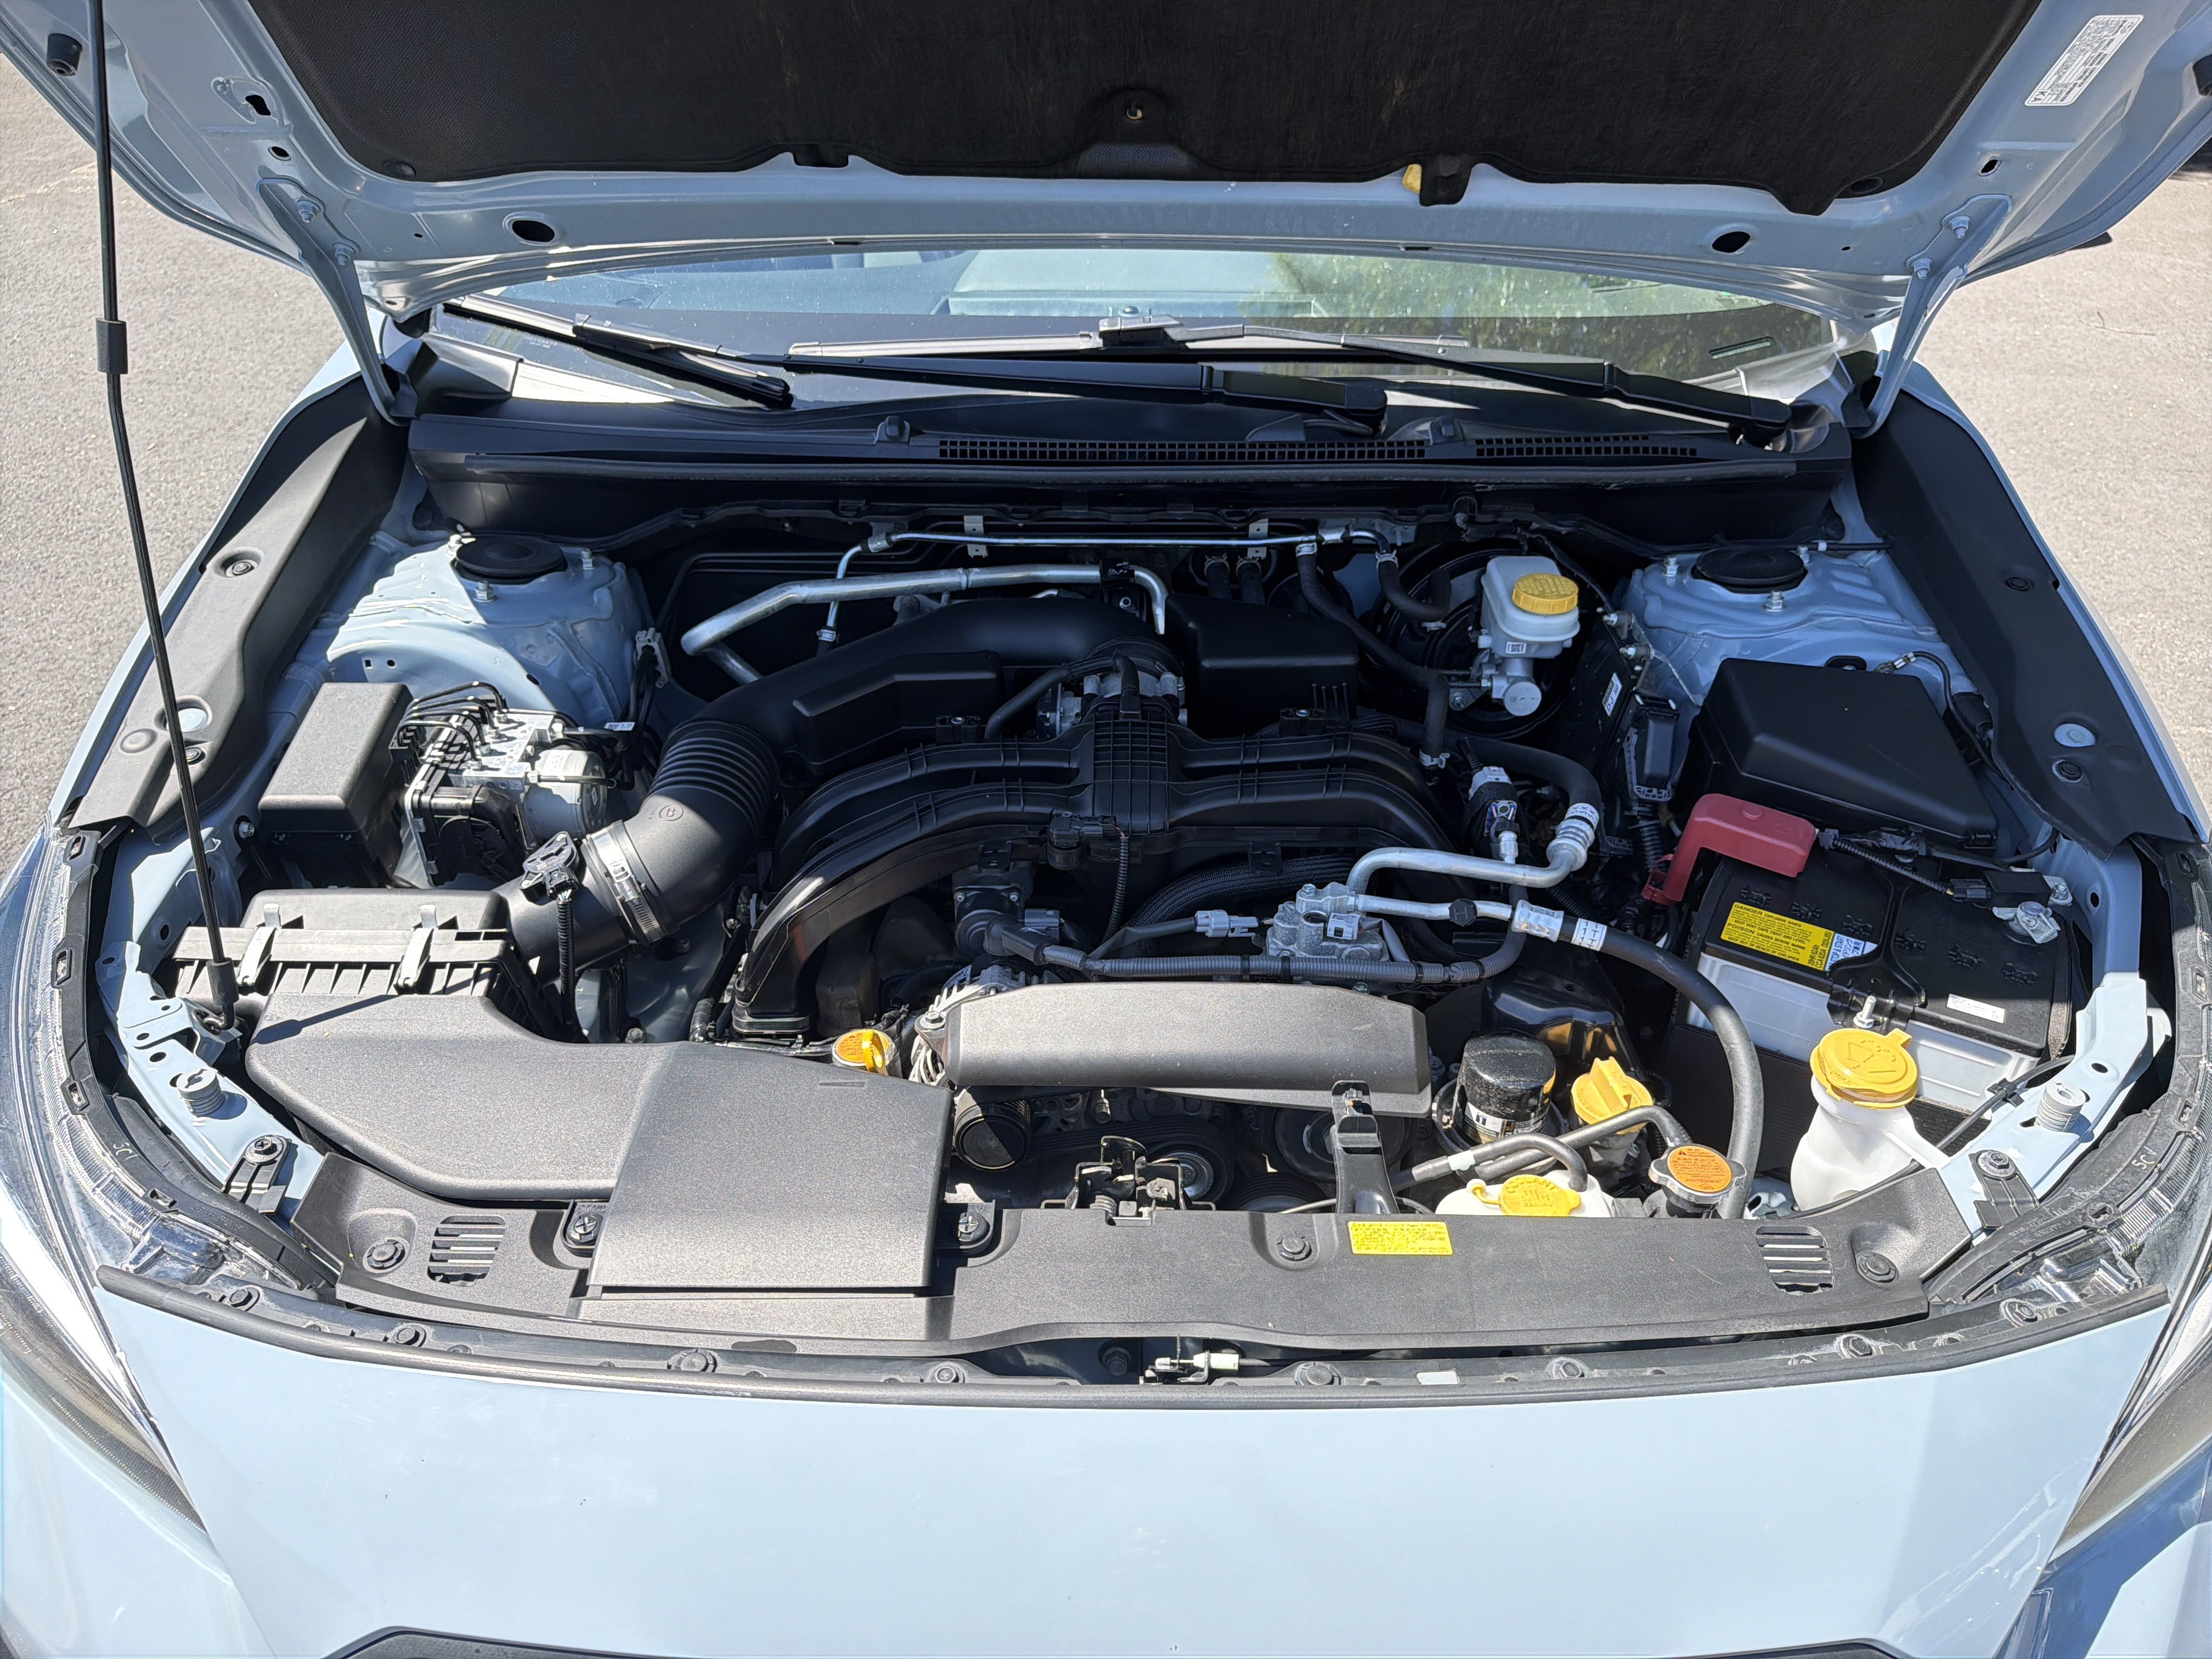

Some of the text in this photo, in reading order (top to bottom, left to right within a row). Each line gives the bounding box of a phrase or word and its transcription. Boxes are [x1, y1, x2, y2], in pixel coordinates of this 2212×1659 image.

[2030, 91, 2047, 102] KA
[1453, 906, 1467, 923] H
[1734, 904, 1763, 916] DANGER
[1764, 913, 1786, 923] EXPLOSIVE
[1592, 929, 1599, 938] T
[1726, 922, 1755, 935] POISON
[1756, 932, 1774, 940] CAUSES
[1774, 937, 1791, 946] SEVERE
[1833, 935, 1845, 949] START
[1776, 951, 1799, 962] CHILDREN
[1830, 951, 1840, 963] STOP
[1505, 1177, 1556, 1193] COOLANT
